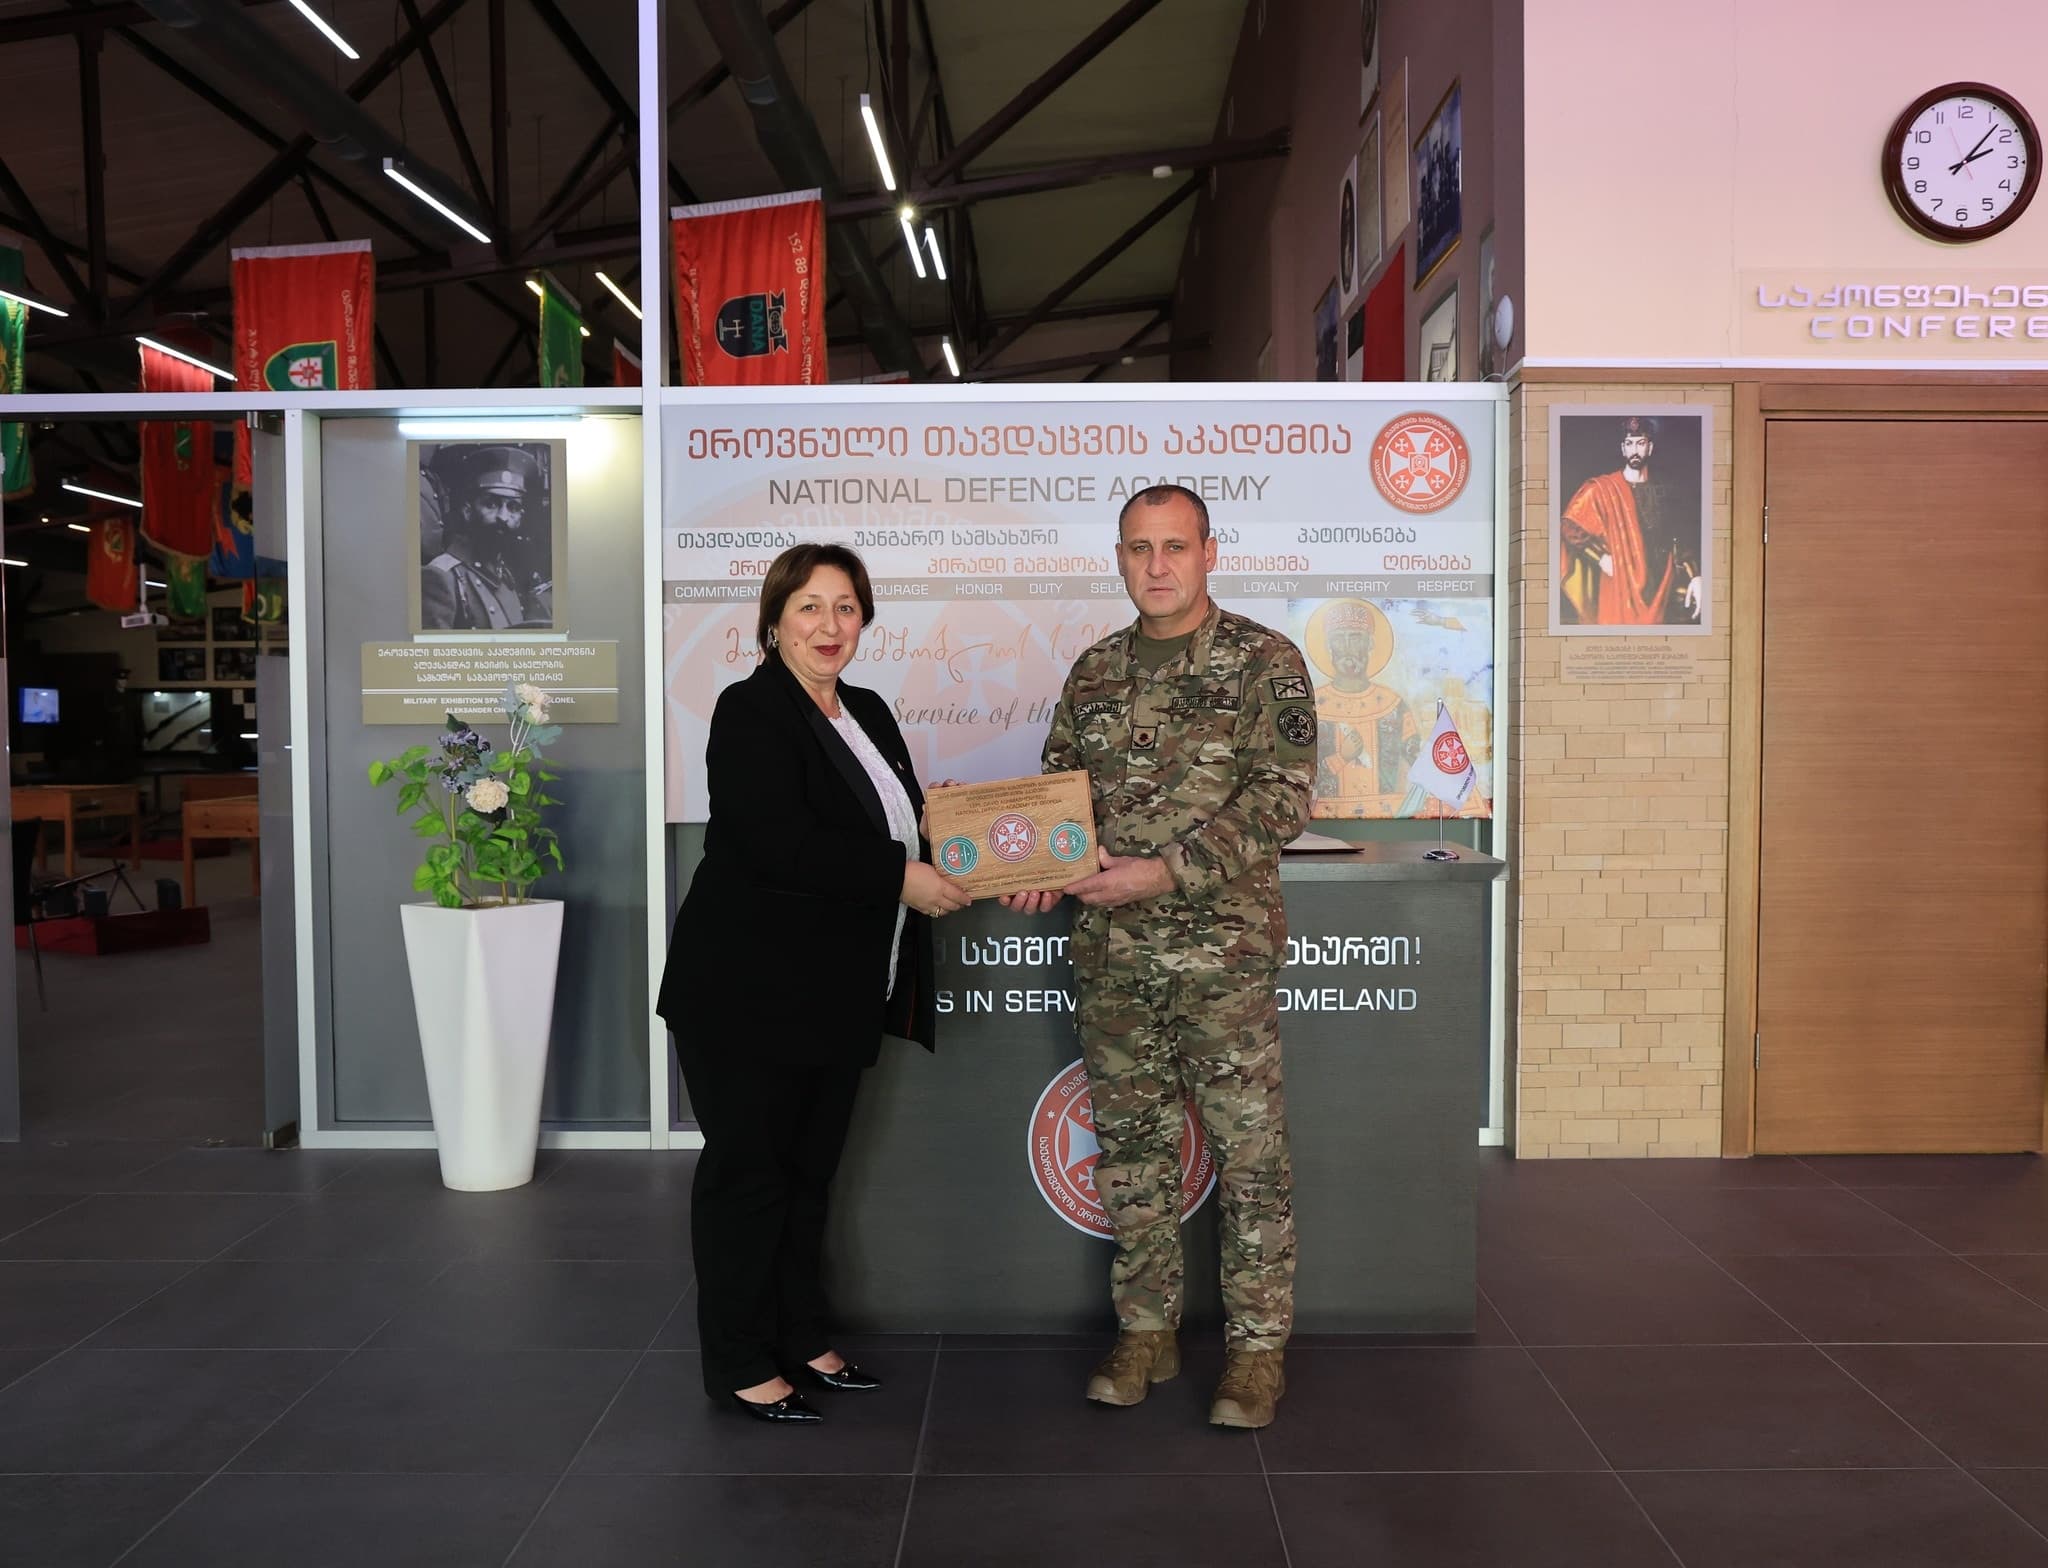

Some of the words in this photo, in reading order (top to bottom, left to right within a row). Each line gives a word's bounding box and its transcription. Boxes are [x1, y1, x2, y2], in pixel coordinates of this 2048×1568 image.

[1936, 111, 1944, 124] 11
[1957, 105, 1974, 119] 12
[1914, 130, 1932, 144] 10
[1999, 129, 2012, 143] 2
[1907, 156, 1920, 170] 9
[2007, 155, 2019, 169] 3
[1914, 179, 1927, 193] 8
[1998, 179, 2011, 192] 4
[1931, 198, 1943, 211] 7
[1982, 198, 1994, 212] 5
[1955, 208, 1968, 221] 6
[1757, 283, 2048, 308] საკონფერენ
[750, 302, 767, 352] DANA
[1810, 314, 2048, 339] CONFERE
[687, 425, 909, 459] ეროვნული
[923, 424, 1148, 457] თავდაცვის
[1163, 423, 1352, 455] აკადემია
[769, 478, 932, 505] NATIONAL
[943, 476, 1096, 503] DEFENCE
[677, 531, 796, 549] თავდადება
[854, 529, 944, 547] უანგარო
[951, 528, 1059, 546] სამსახური
[1297, 527, 1417, 544] პატიოსნება
[927, 556, 1007, 575] პირადი
[1013, 555, 1109, 573] მამაცობა
[1215, 555, 1310, 572] ივისცემა
[1383, 554, 1472, 571] ღირსება
[871, 584, 929, 597] OURAGE
[954, 583, 1004, 595] HONOR
[1029, 583, 1063, 594] DUTY
[1243, 581, 1300, 593] LOYALTY
[1326, 580, 1391, 592] INTEGRITY
[1417, 580, 1476, 592] RESPECT
[403, 697, 438, 705] MILITARY
[484, 697, 506, 705] SPA
[551, 696, 577, 705] LONEL
[989, 696, 1019, 731] of
[1027, 696, 1053, 725] th
[960, 936, 1074, 966] სამშო
[1285, 935, 1422, 966] ახურში!
[966, 989, 993, 1013] IN
[1005, 989, 1077, 1013] SERV
[1275, 988, 1417, 1011] OMELAND
